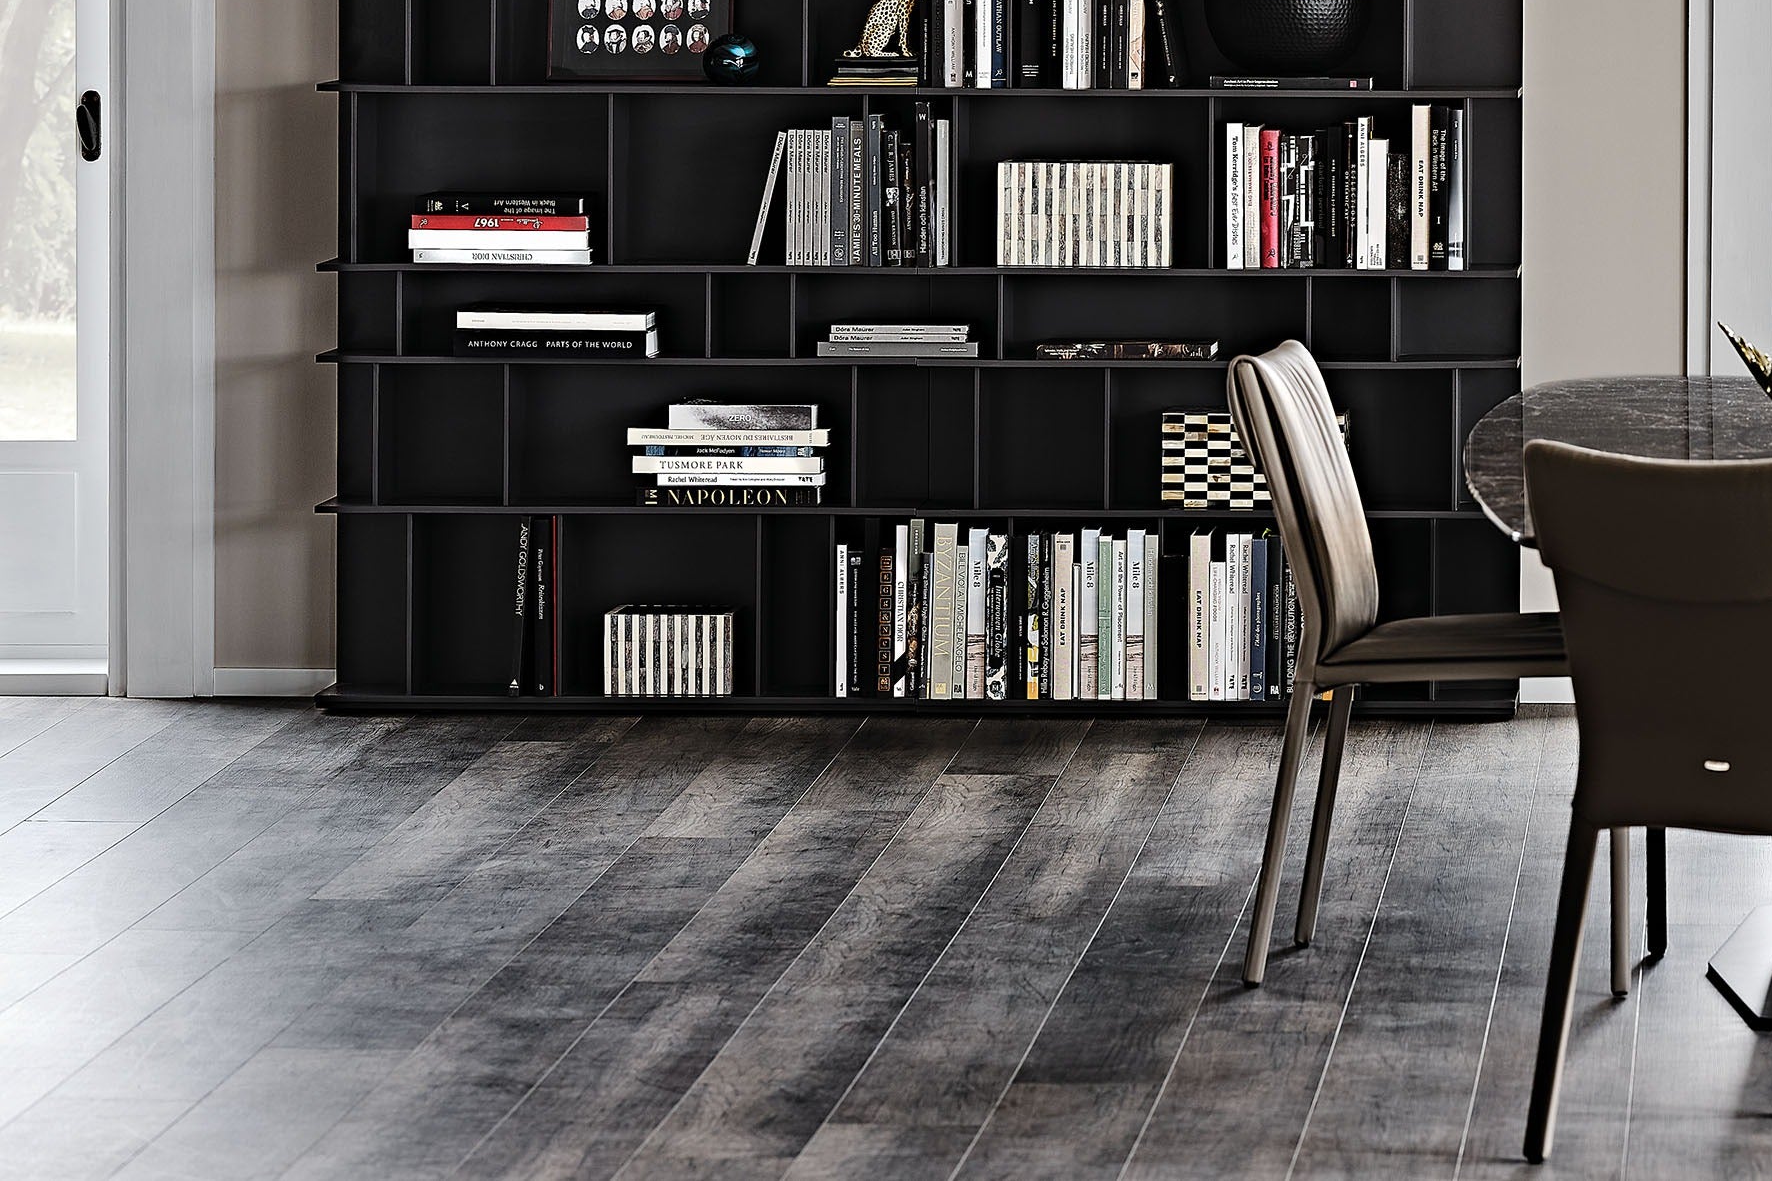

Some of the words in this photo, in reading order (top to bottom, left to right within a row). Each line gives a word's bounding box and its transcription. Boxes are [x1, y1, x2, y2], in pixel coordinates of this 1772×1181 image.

[853, 138, 861, 171] MEALS
[1231, 136, 1239, 153] Tom
[1231, 154, 1239, 191] Kerridge's
[853, 173, 861, 223] 30-MINUTE
[474, 218, 499, 227] 1967
[919, 213, 927, 225] och
[853, 223, 861, 262] JAMIE'S
[919, 226, 927, 254] Handen
[660, 460, 713, 470] TUSMORE
[716, 460, 743, 470] PARK
[668, 475, 687, 483] Rachel
[688, 475, 718, 483] Whiteread
[668, 489, 787, 504] NAPOLEON
[520, 523, 528, 550] ANDY
[958, 552, 966, 569] BILL
[973, 560, 981, 581] Mile
[1086, 561, 1095, 581] Mile
[1132, 561, 1140, 581] Mile
[515, 551, 526, 616] GOLDSWORTHY
[957, 572, 965, 597] VIOLA
[1042, 567, 1051, 609] Guggenheim
[934, 536, 953, 657] BYZANTIUM
[1041, 617, 1049, 646] Solomon
[1286, 598, 1295, 642] REVOLUTION
[955, 603, 963, 671] MICHELANGELO
[1286, 644, 1295, 657] THE
[1041, 658, 1050, 678] Rebay
[1286, 659, 1295, 693] BUILDING
[1040, 679, 1048, 694] Hilla
